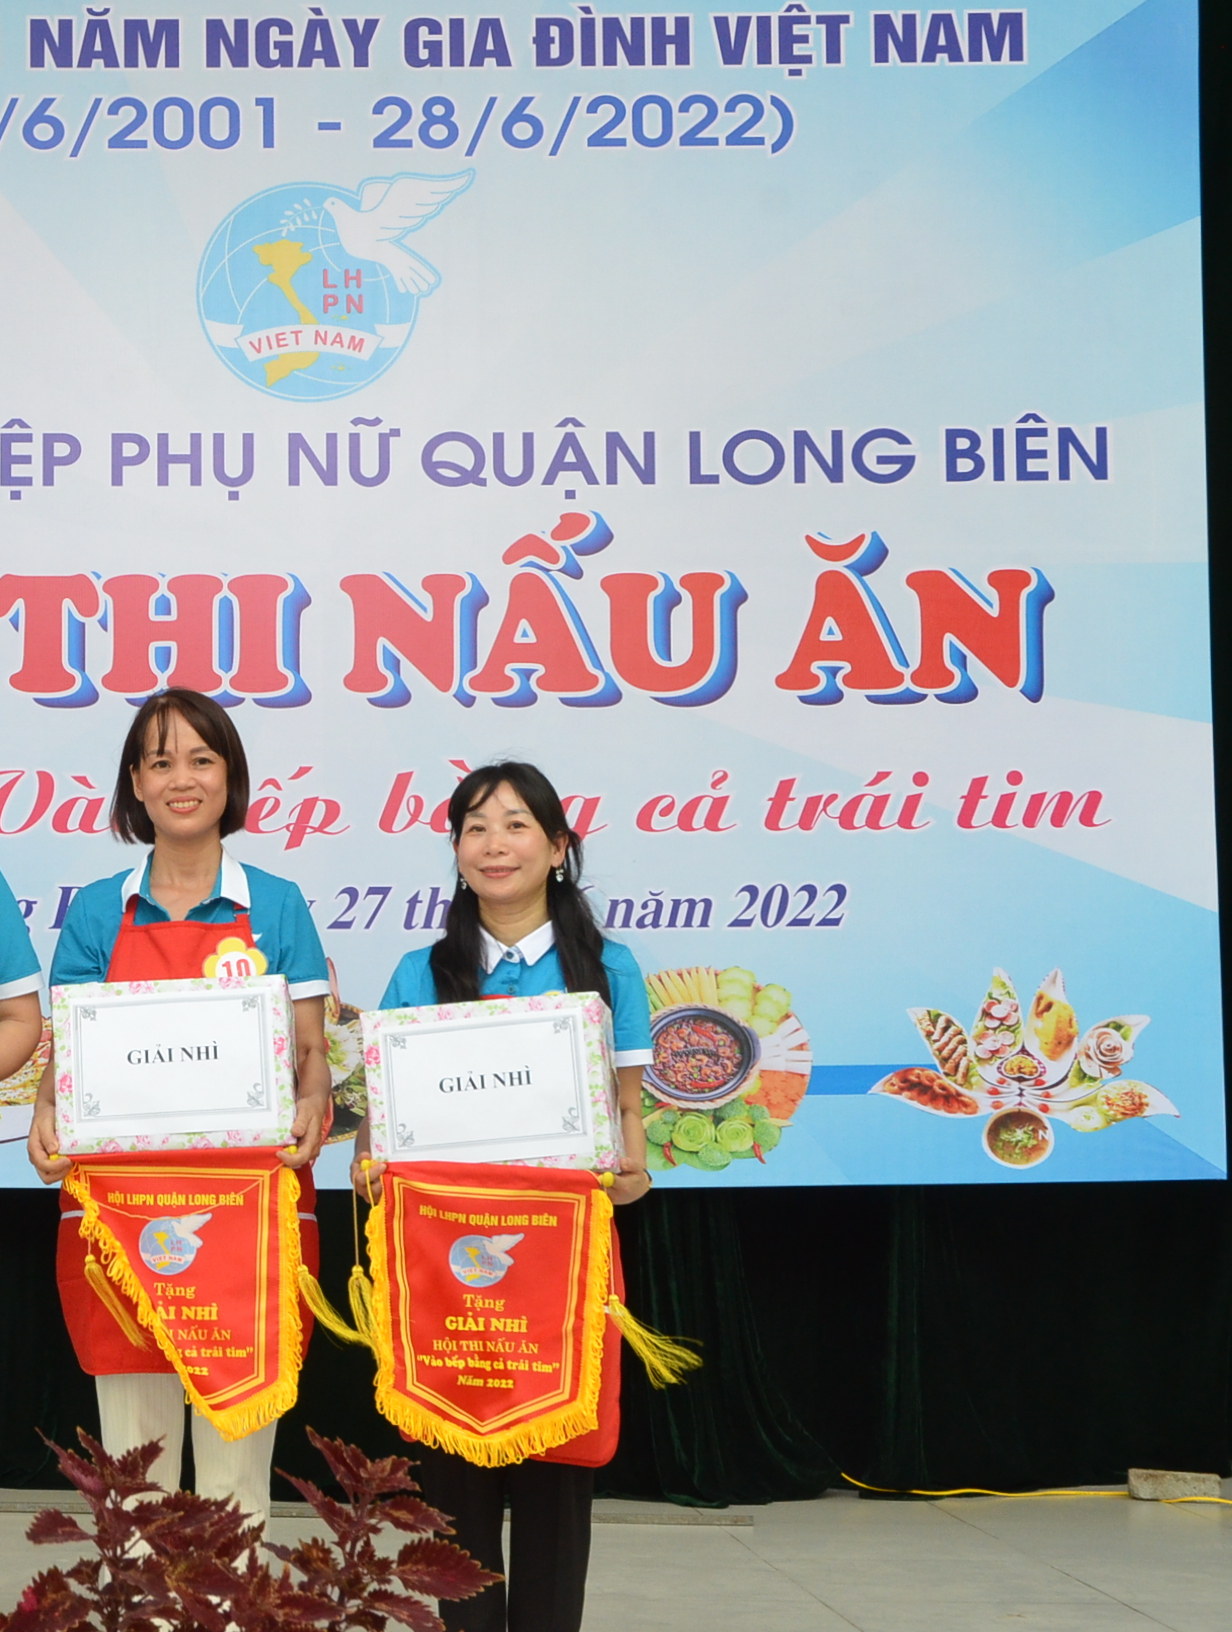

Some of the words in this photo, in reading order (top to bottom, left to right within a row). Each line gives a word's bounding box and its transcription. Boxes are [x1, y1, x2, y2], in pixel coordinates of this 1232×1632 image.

[29, 7, 180, 69] NĂM
[206, 8, 381, 69] NGÀY
[404, 17, 513, 68] GIA
[533, 6, 691, 67] ĐÌNH
[713, 3, 851, 77] VIỆT
[873, 12, 1025, 64] NAM
[318, 122, 343, 132] -
[371, 93, 796, 157] 28/6/2022)
[248, 330, 304, 354] VIET
[314, 330, 366, 353] NAM
[111, 432, 256, 502] PHỤ
[287, 416, 402, 488] NỮ
[421, 417, 657, 500] QUẬN
[689, 427, 917, 486] LONG
[944, 412, 1110, 482] BIÊN
[340, 510, 747, 707] NẤU
[775, 531, 1055, 703] ĂN
[244, 766, 350, 850] ếp
[635, 768, 736, 833] cả
[764, 770, 932, 833] trái
[957, 769, 1111, 831] tim
[326, 886, 394, 931] 27
[604, 886, 714, 931] năm
[727, 883, 848, 930] 2022
[127, 1044, 173, 1065] GIẢI
[180, 1040, 219, 1062] NHÌ
[439, 1070, 485, 1094] GIẢI
[492, 1065, 532, 1089] NHÌ
[107, 1191, 125, 1207] HỘI
[127, 1193, 155, 1206] LHPN
[157, 1191, 186, 1208] QUẬN
[188, 1194, 216, 1206] LONG
[219, 1191, 244, 1206] BIÊN
[419, 1205, 437, 1219] HỘI
[439, 1210, 467, 1224] LHPN
[469, 1212, 499, 1229] QUẬN
[501, 1215, 529, 1226] LONG
[531, 1213, 558, 1227] BIÊN
[154, 1282, 196, 1299] Tặng
[181, 1302, 218, 1320] NHÌ
[463, 1294, 506, 1311] Tặng
[178, 1325, 208, 1340] NẤU
[211, 1327, 231, 1341] ĂN
[445, 1312, 486, 1331] GIẢI
[490, 1315, 528, 1333] NHÌ
[201, 1346, 223, 1358] trái
[433, 1337, 457, 1354] HỘI
[460, 1340, 484, 1352] THI
[486, 1337, 515, 1353] NẤU
[519, 1340, 539, 1354] ĂN
[445, 1354, 466, 1370] bếp
[468, 1354, 492, 1371] bằng
[507, 1358, 529, 1371] trái
[457, 1374, 484, 1387] Năm
[486, 1378, 514, 1388] 2022
